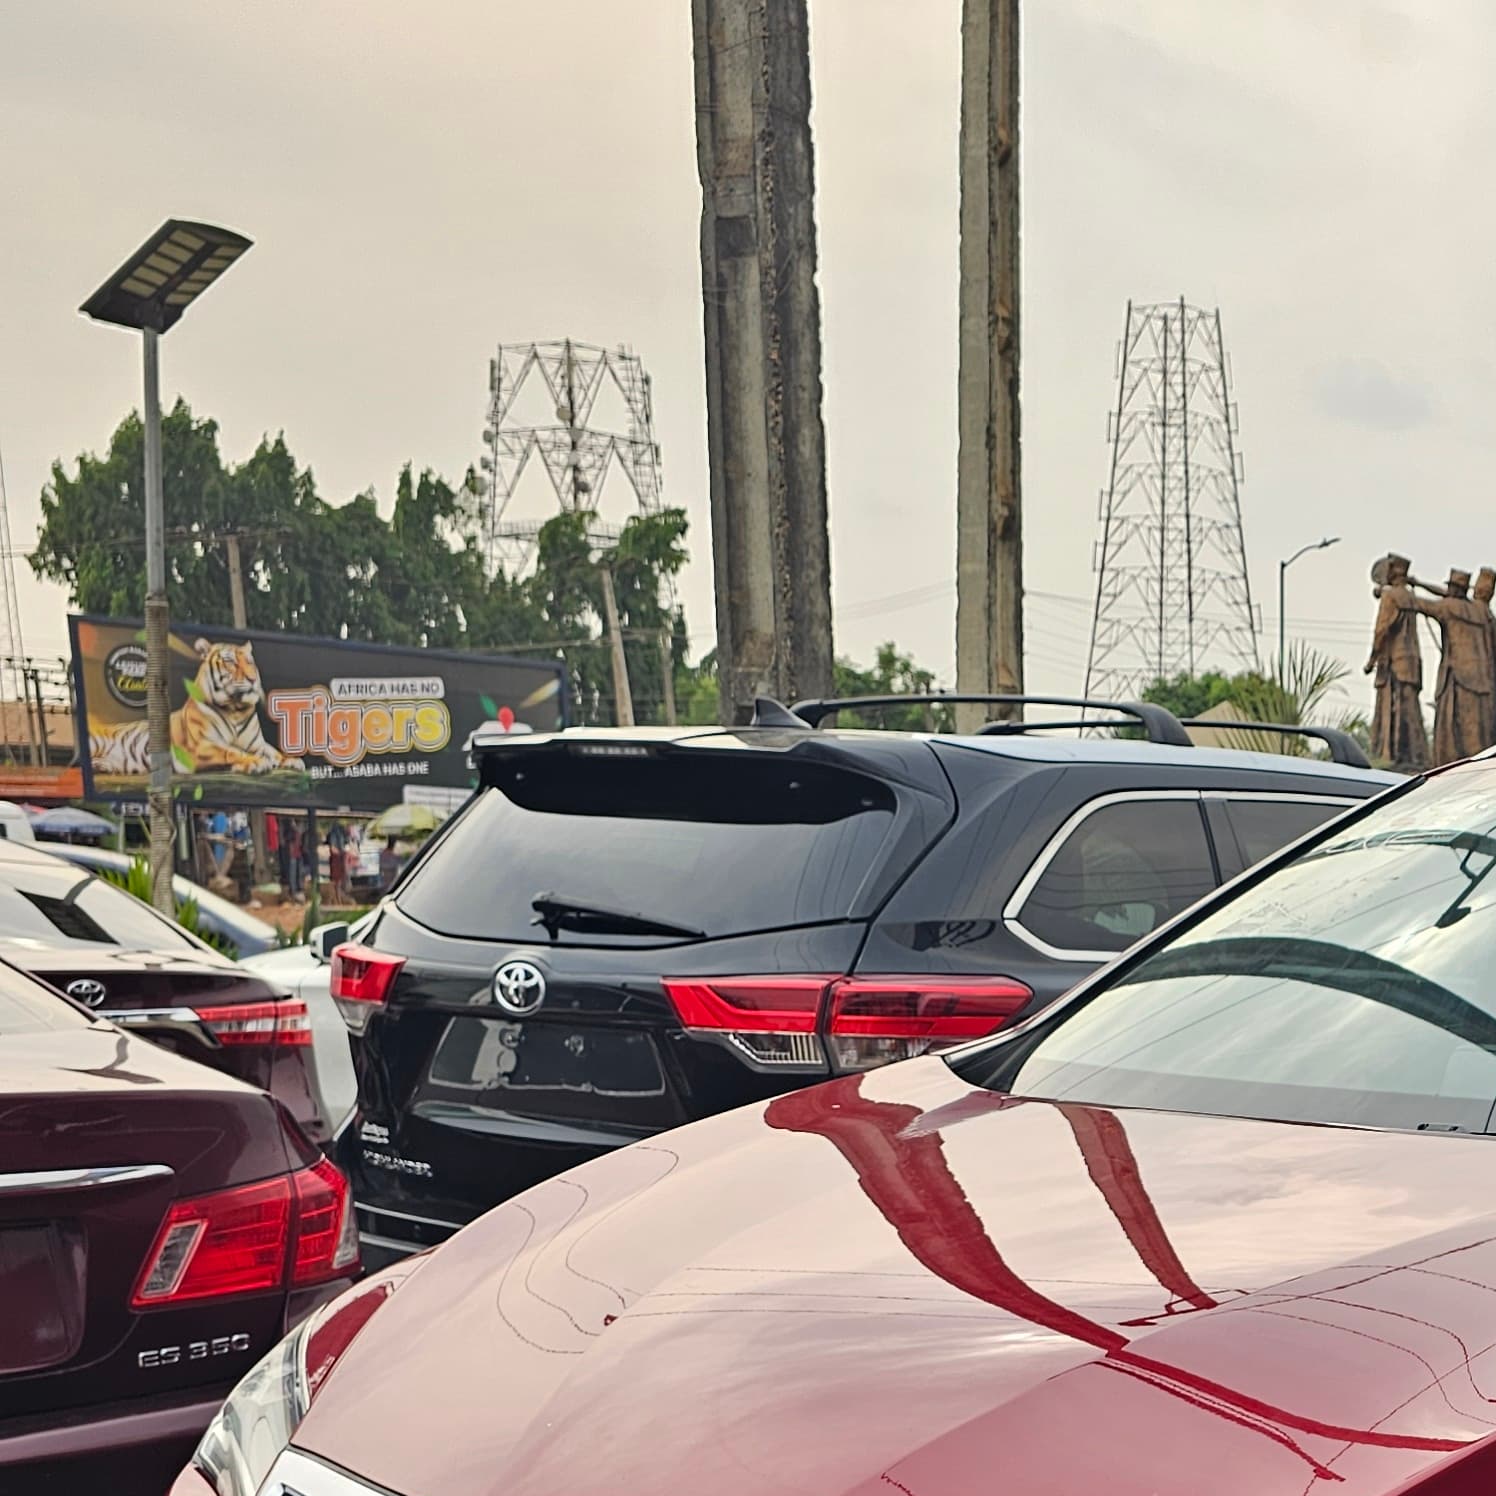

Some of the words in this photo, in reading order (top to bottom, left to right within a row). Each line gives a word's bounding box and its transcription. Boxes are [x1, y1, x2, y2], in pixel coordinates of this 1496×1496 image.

[337, 681, 388, 697] AFRICA
[390, 681, 418, 696] HAS
[421, 680, 441, 695] NO
[272, 692, 446, 762] Tigers
[344, 763, 381, 777] ASABA
[382, 762, 405, 776] HAS
[406, 760, 430, 775] ONE
[138, 1346, 181, 1368] ES
[188, 1333, 250, 1360] 350
